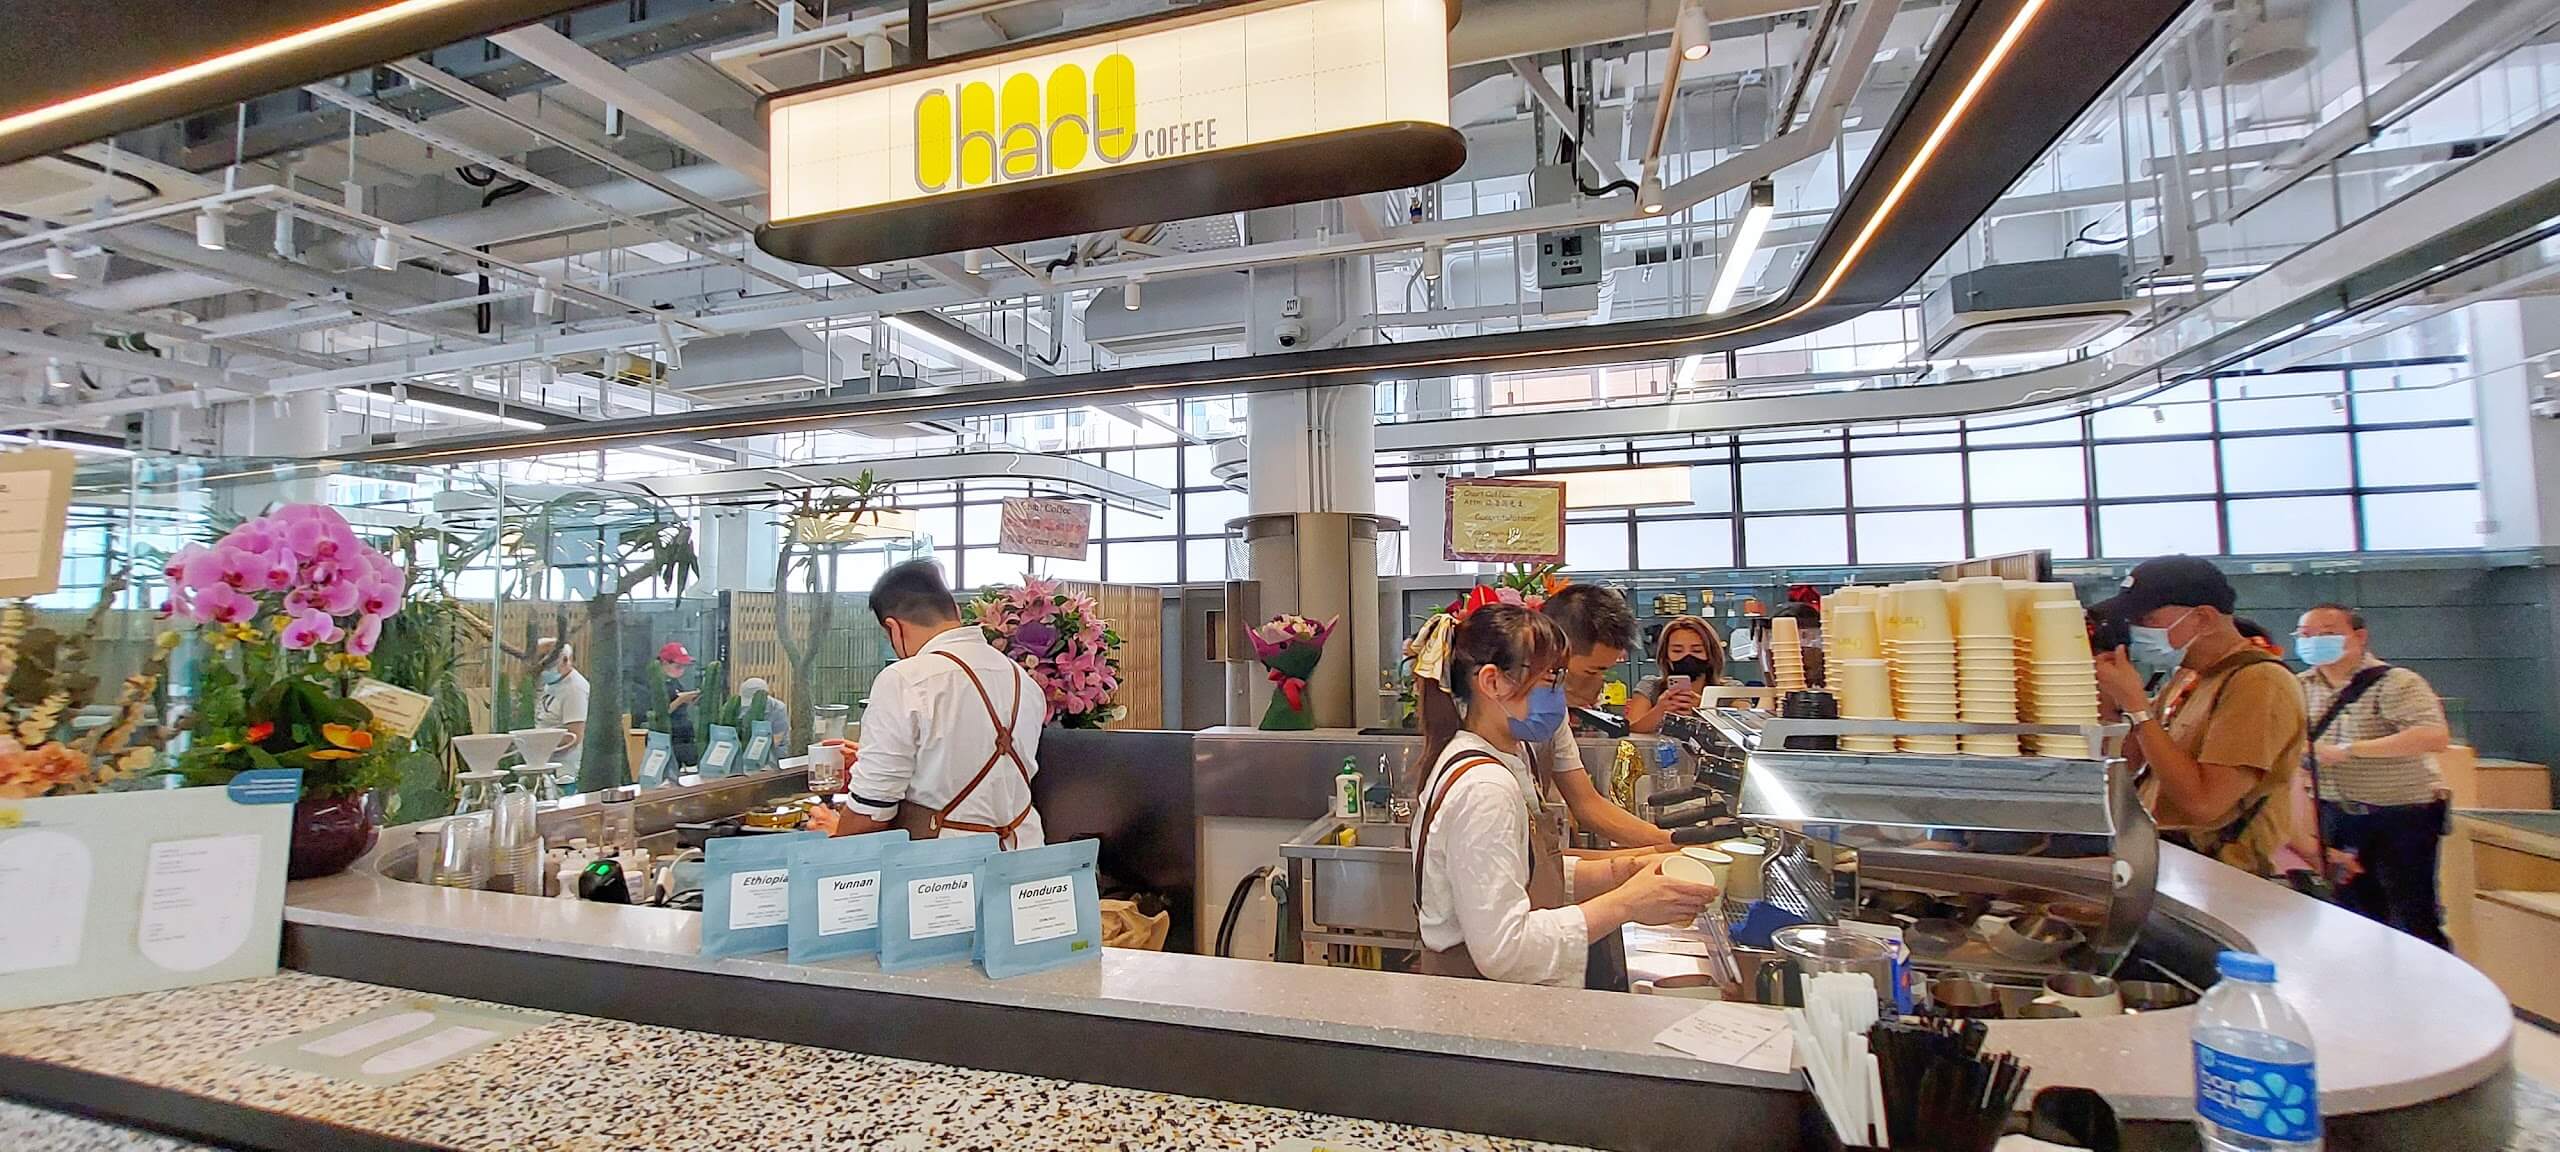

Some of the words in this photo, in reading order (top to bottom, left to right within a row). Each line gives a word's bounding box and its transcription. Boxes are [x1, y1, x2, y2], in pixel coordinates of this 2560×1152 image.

[913, 84, 1138, 194] Chart
[1144, 118, 1217, 159] COFFEE
[743, 873, 788, 887] Ethiopia
[833, 878, 874, 891] Yunnan
[917, 879, 968, 895] Colombia
[1018, 883, 1068, 900] Honduras
